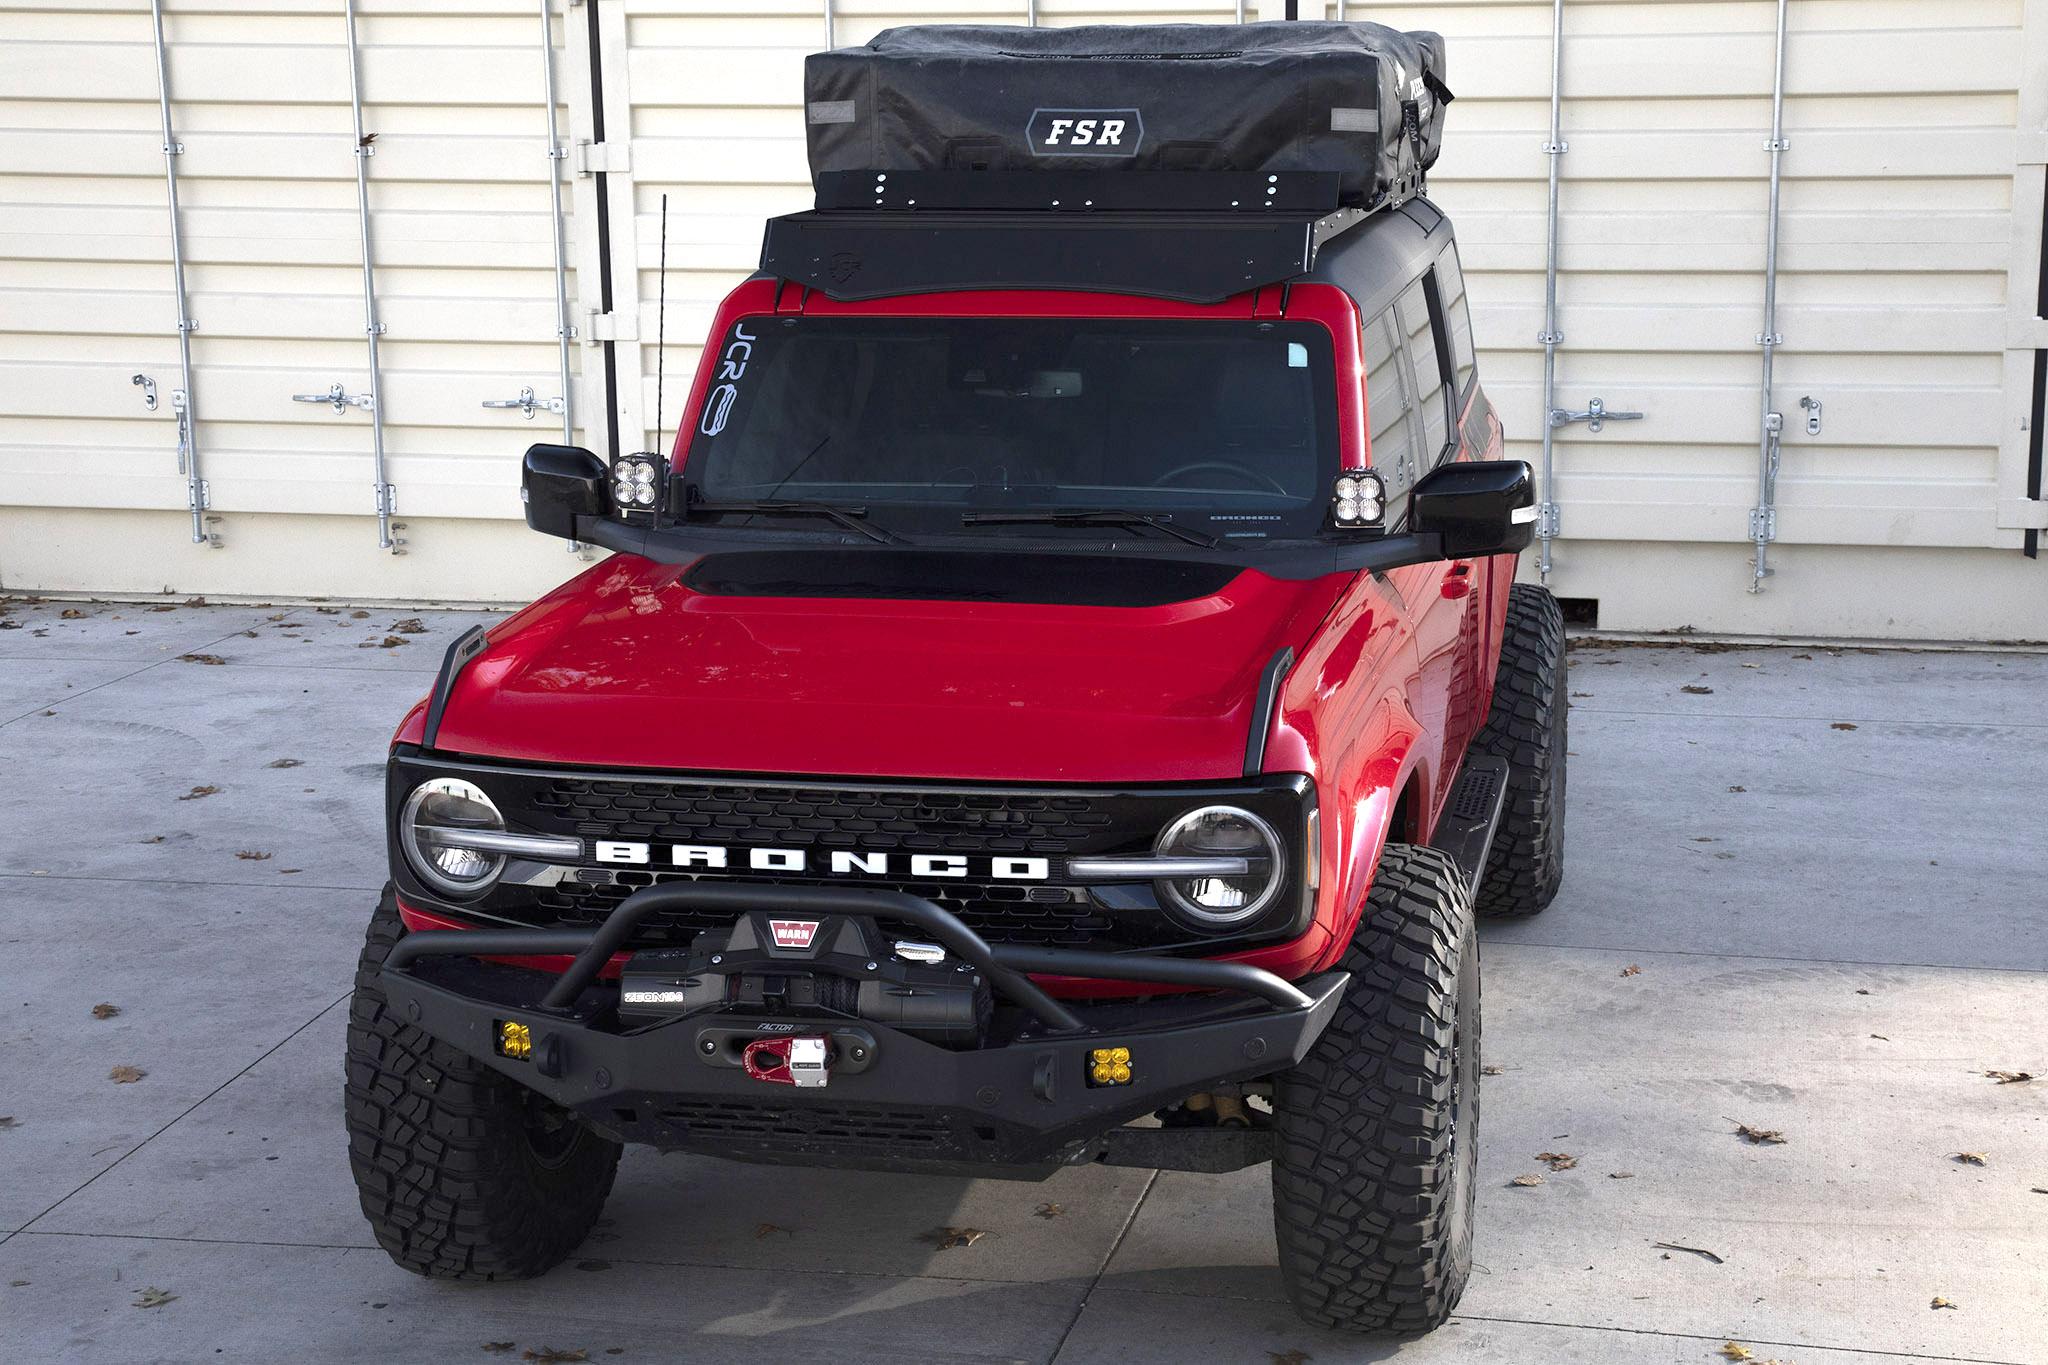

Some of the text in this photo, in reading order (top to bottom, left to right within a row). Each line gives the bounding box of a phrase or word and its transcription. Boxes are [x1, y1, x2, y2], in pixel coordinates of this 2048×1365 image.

[1045, 119, 1125, 145] FSR
[718, 323, 757, 380] JCR
[595, 840, 1050, 879] BRONCO
[777, 928, 810, 940] WARN
[757, 1023, 794, 1031] FACTOR
